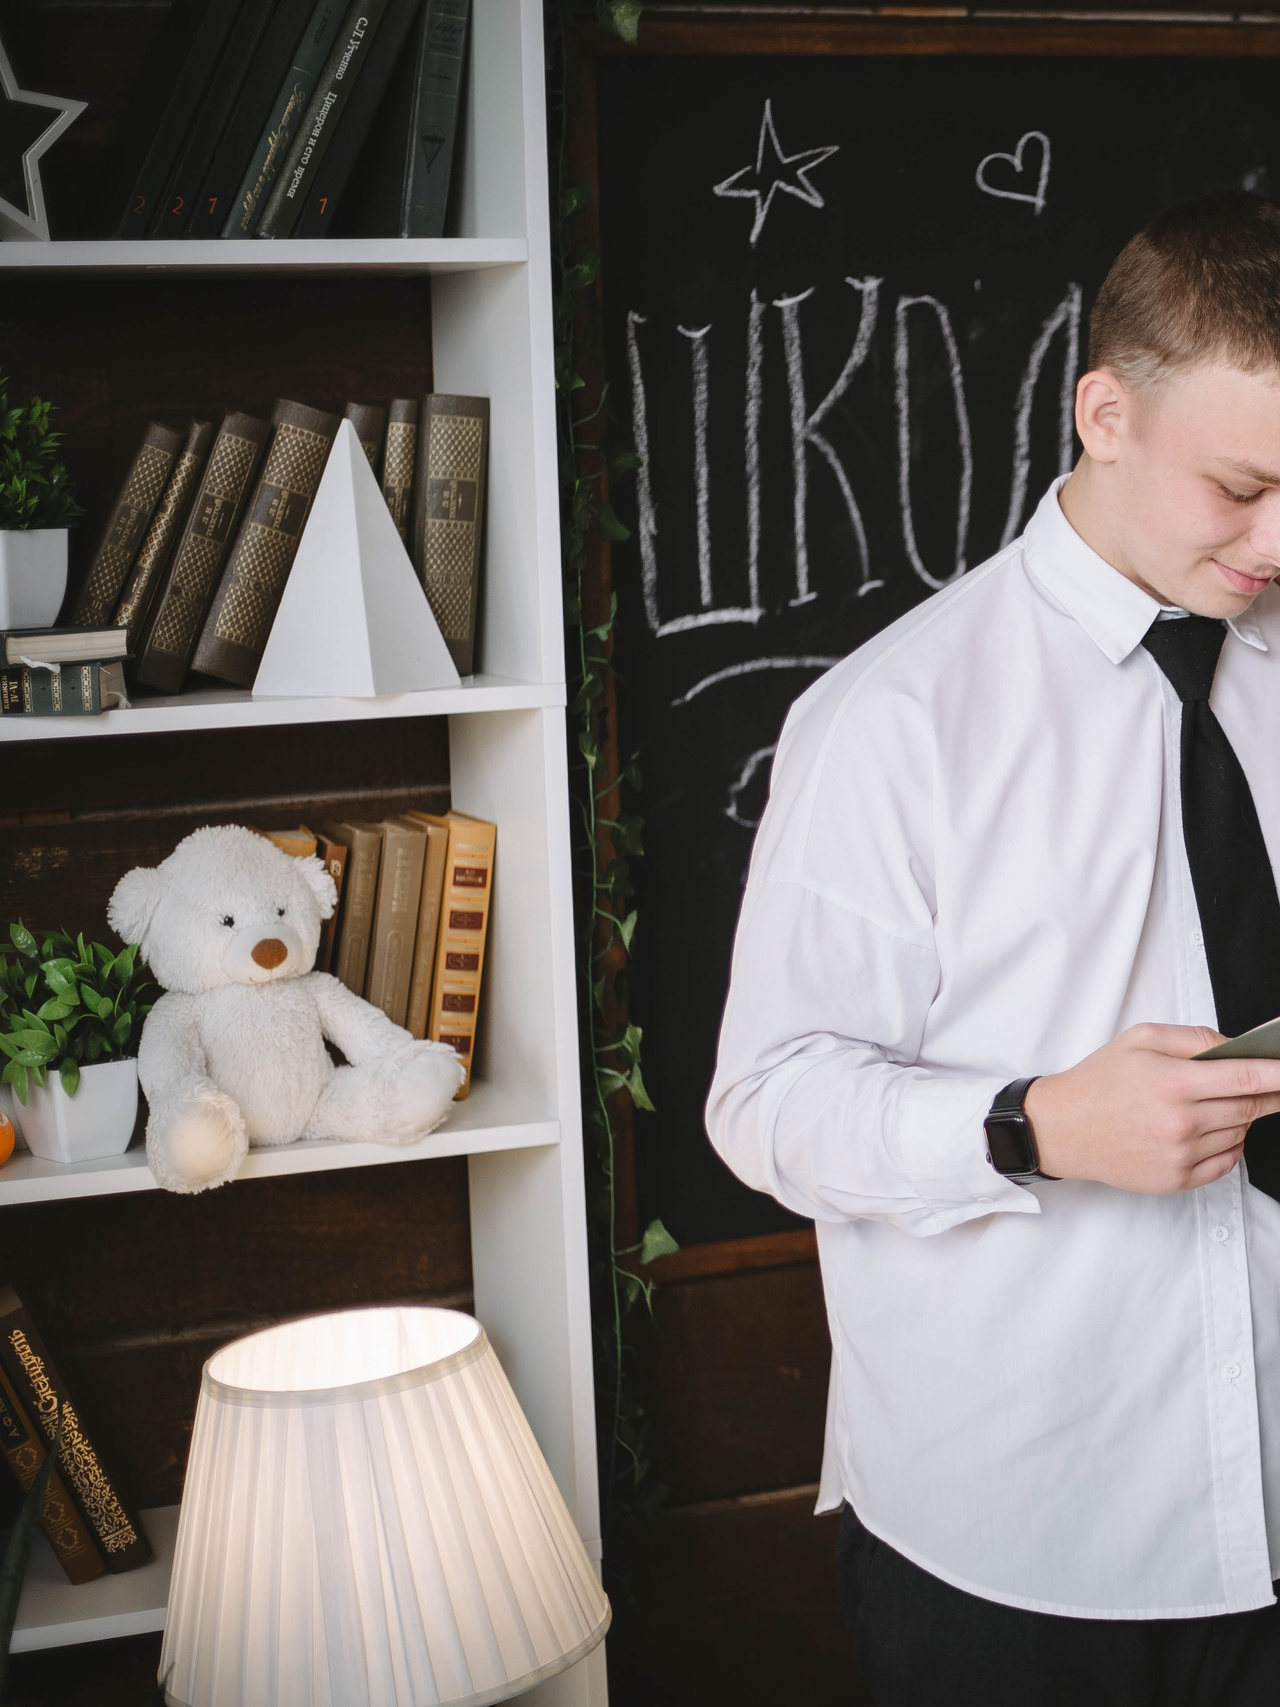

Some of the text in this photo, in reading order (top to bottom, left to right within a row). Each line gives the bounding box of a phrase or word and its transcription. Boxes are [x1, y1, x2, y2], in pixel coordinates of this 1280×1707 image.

[335, 38, 361, 80] Утченко
[286, 91, 338, 199] Цицерон и его время
[133, 195, 146, 214] 2
[171, 196, 184, 215] 2
[120, 508, 139, 546] ТОЛСТОЙ
[205, 498, 223, 537] ТОЛСТОЙ
[2, 675, 10, 710] КНИЖКИ
[9, 681, 19, 703] IV-VI
[8, 1329, 58, 1413] Стендаль
